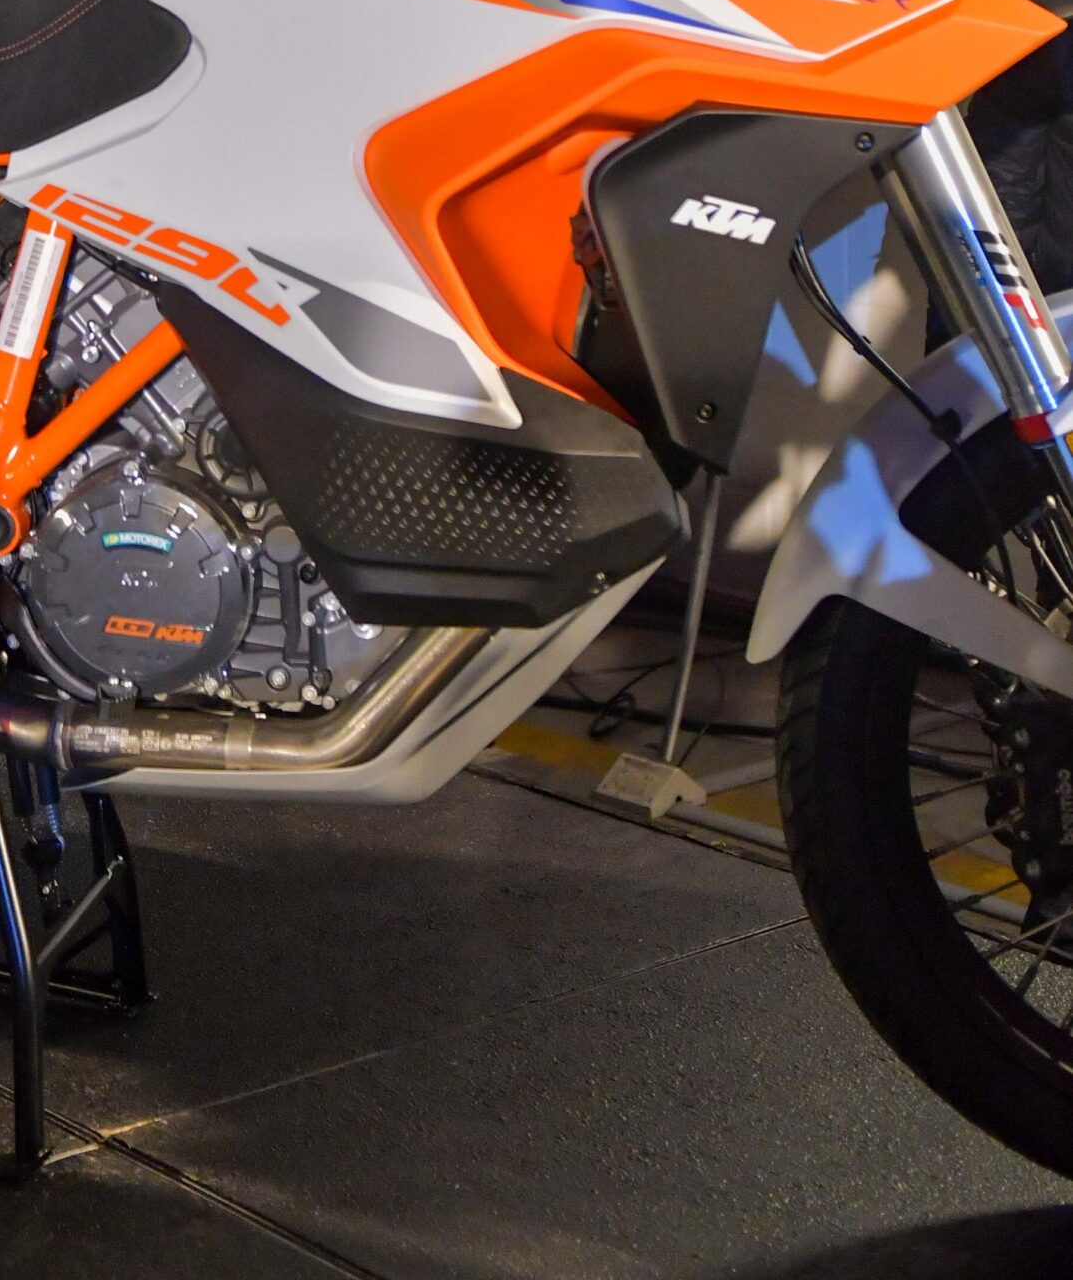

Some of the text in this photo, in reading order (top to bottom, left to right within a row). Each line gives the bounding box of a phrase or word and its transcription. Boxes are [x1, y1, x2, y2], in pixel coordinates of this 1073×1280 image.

[670, 194, 777, 245] KTM
[118, 531, 170, 552] MOTOREX
[155, 624, 205, 645] KTM
